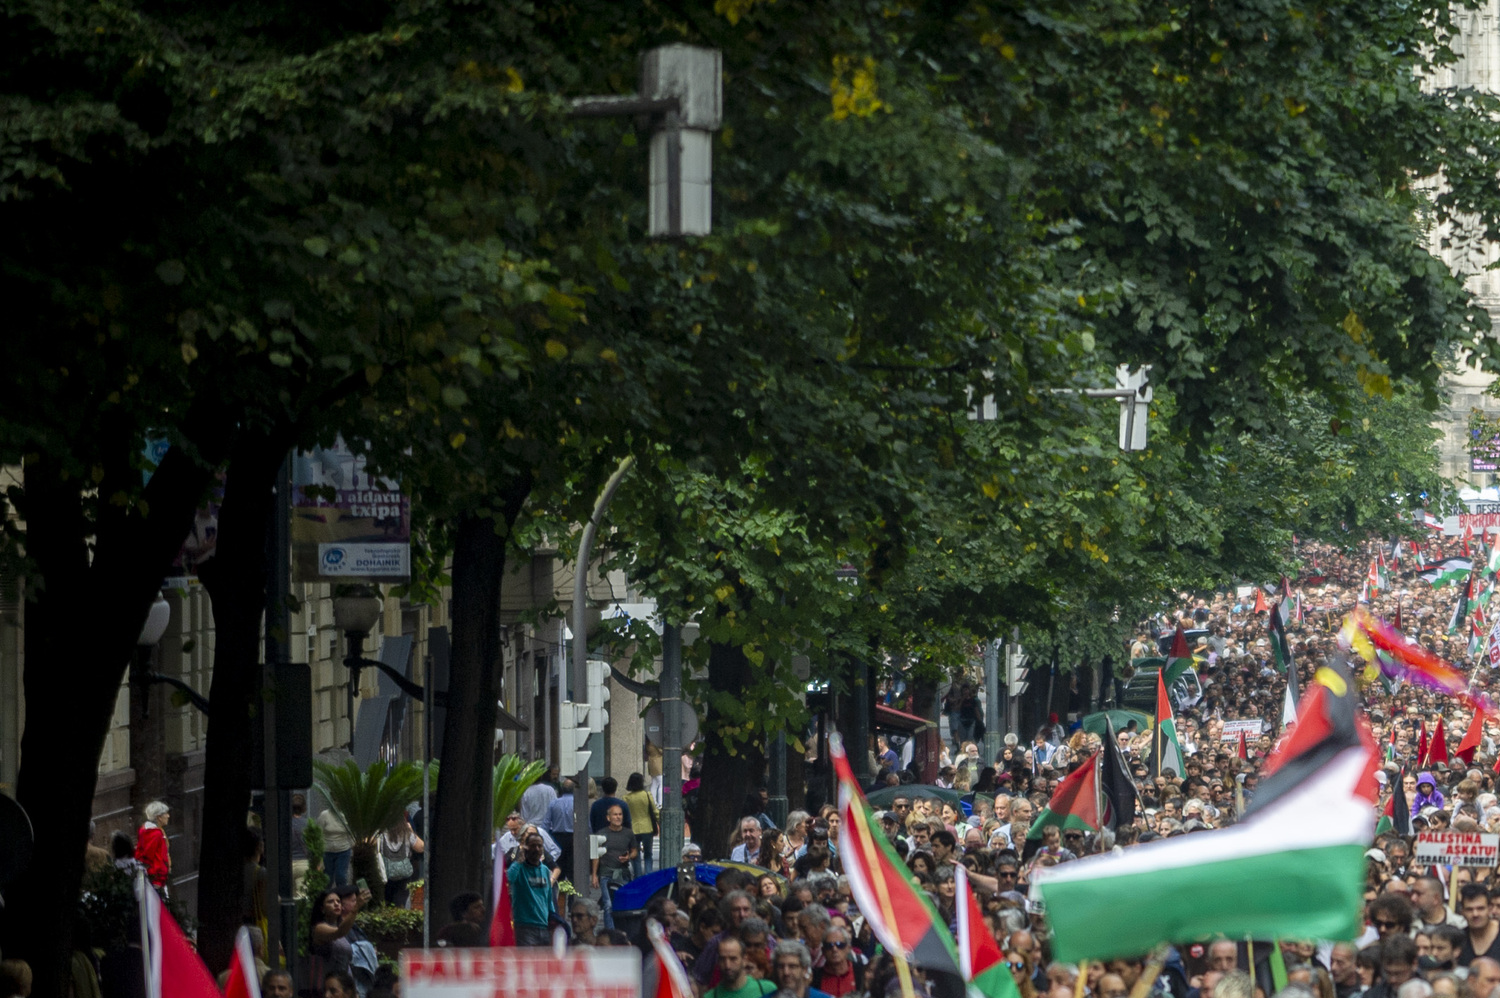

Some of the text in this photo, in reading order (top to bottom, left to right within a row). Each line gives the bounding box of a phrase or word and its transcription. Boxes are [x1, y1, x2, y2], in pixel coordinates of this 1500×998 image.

[350, 503, 400, 520] txipa
[356, 559, 400, 568] DOHAINIK
[1418, 833, 1482, 844] PALESTINA
[1446, 845, 1497, 857] ASKATU!
[1417, 855, 1495, 865] ISRAELI BOIKOT
[408, 954, 591, 982] PALESTINA
